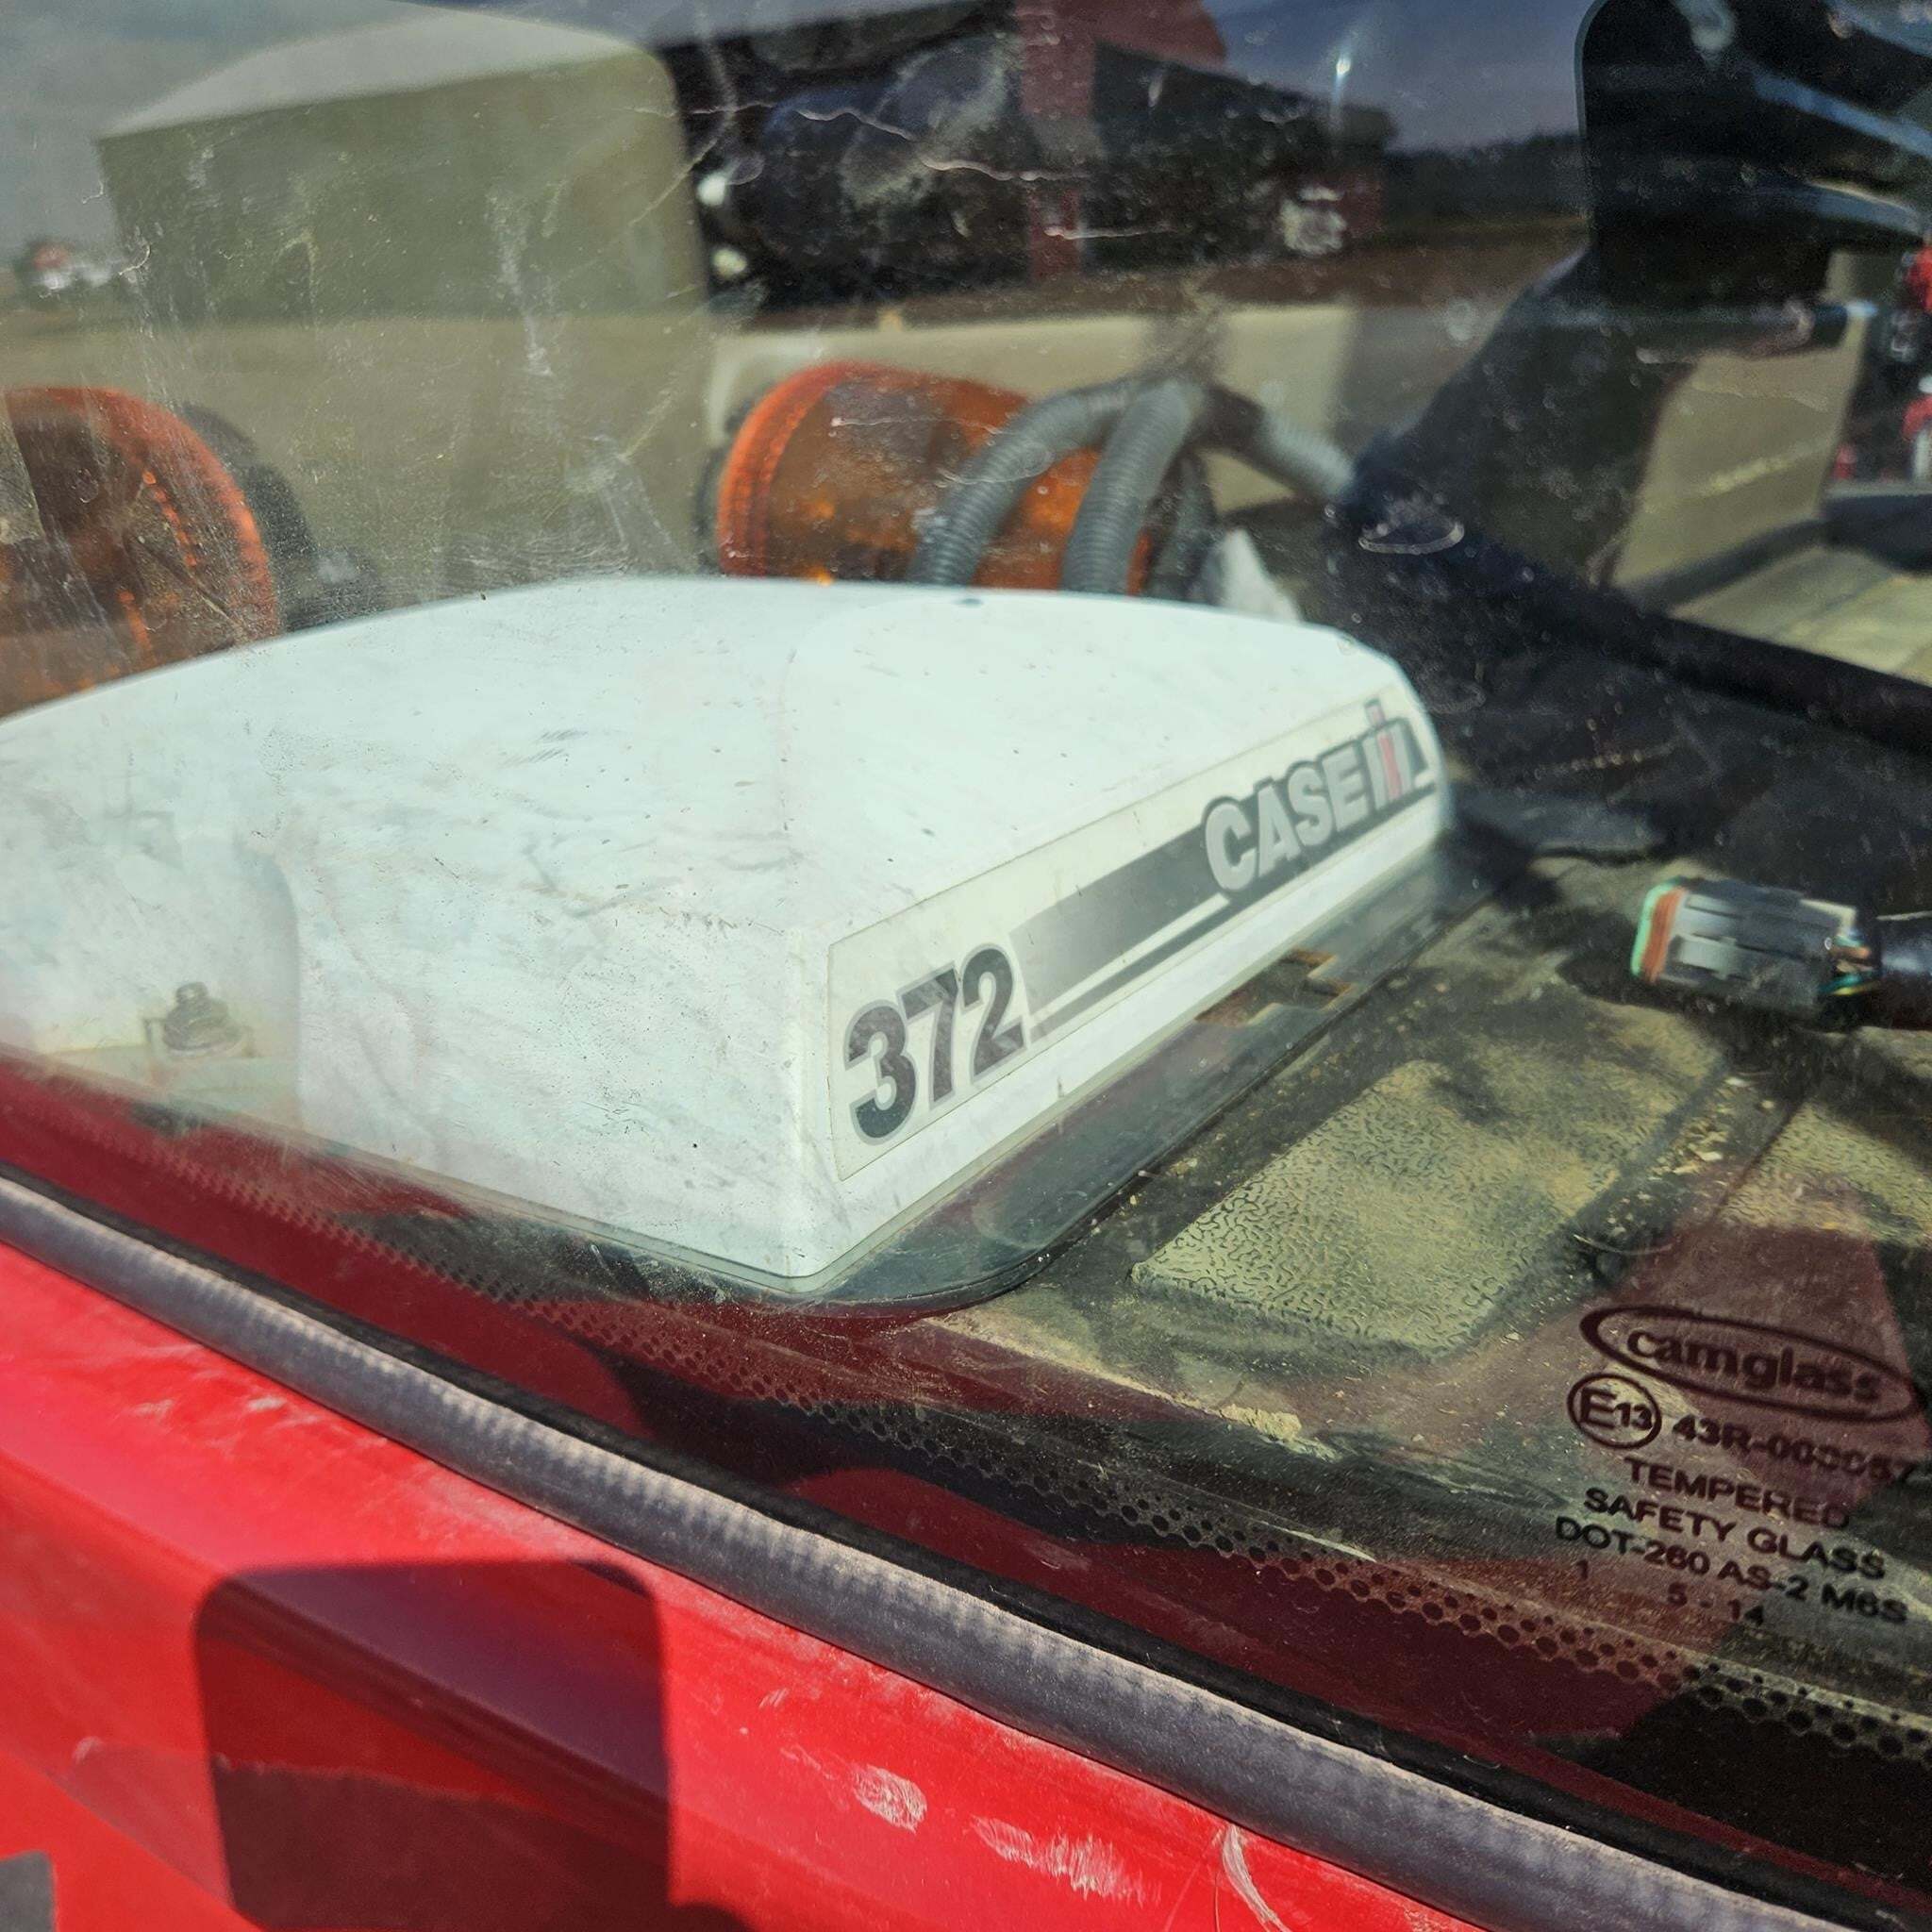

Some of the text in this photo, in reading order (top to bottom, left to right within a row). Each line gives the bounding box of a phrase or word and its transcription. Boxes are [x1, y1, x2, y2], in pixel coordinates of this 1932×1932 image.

[845, 943, 1028, 1146] 372
[1626, 1329, 1882, 1403] camglass
[1624, 1457, 1850, 1530] TEMPERED
[1583, 1487, 1887, 1580] SAFETY GLASS
[1717, 1559, 1809, 1602] AS-2
